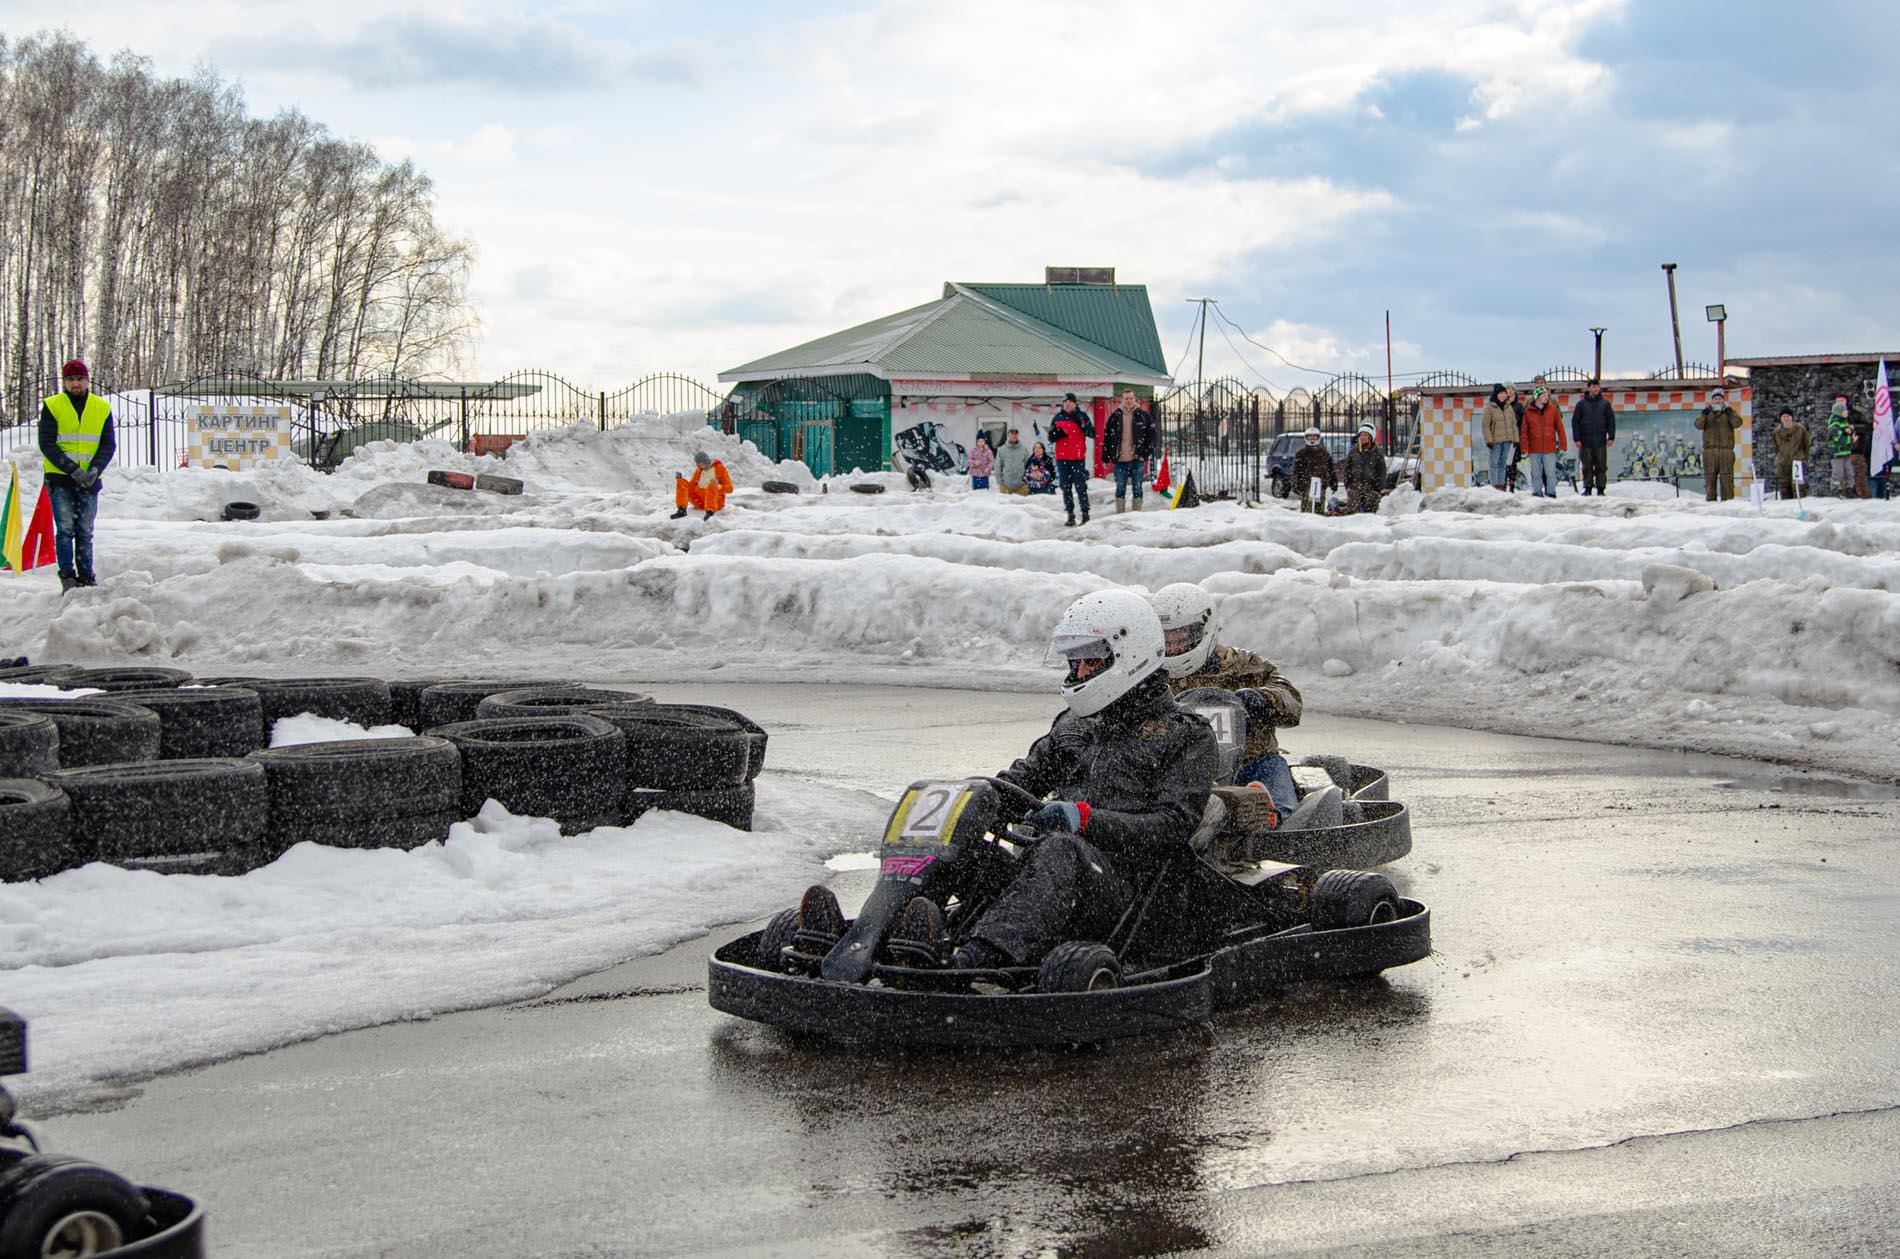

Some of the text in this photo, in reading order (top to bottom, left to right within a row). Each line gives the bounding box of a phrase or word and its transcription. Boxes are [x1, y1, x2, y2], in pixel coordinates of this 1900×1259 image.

[197, 414, 281, 430] КАРТИНГ
[209, 438, 271, 456] ЦЕНТР
[1794, 463, 1800, 478] 2
[909, 789, 950, 831] 2
